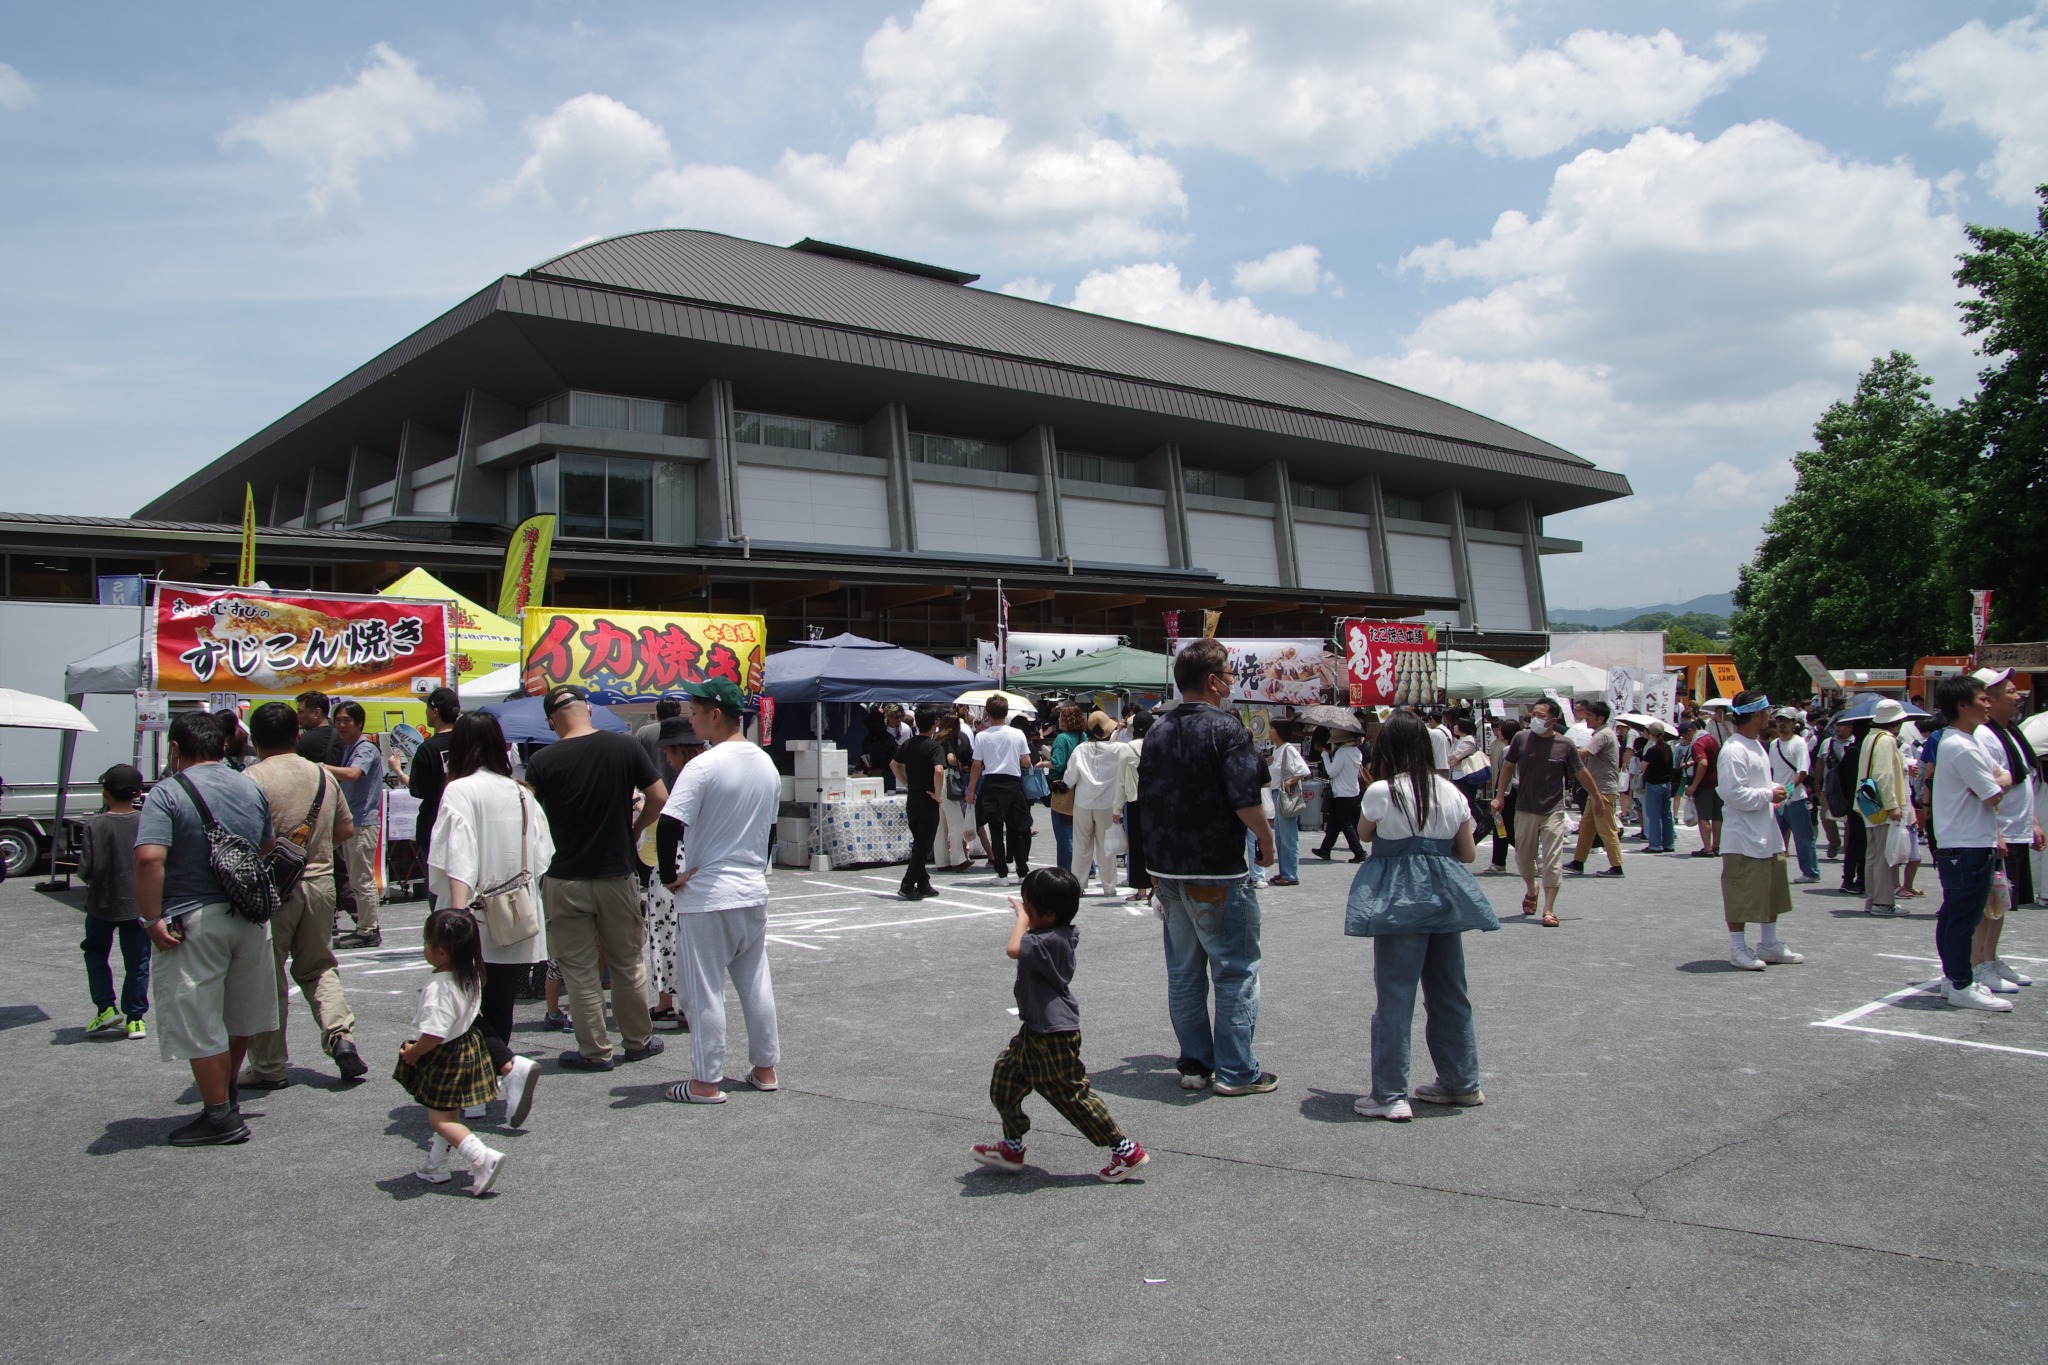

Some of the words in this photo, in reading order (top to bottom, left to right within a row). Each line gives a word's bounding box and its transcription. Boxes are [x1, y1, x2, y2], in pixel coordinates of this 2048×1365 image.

[703, 623, 756, 643] 味自慢
[1369, 626, 1423, 644] たこ焼き本舗
[179, 617, 424, 683] すじこん焼き
[527, 615, 742, 691] イカ焼き
[1719, 674, 1736, 682] LAND
[1646, 692, 1658, 716] ベビ
